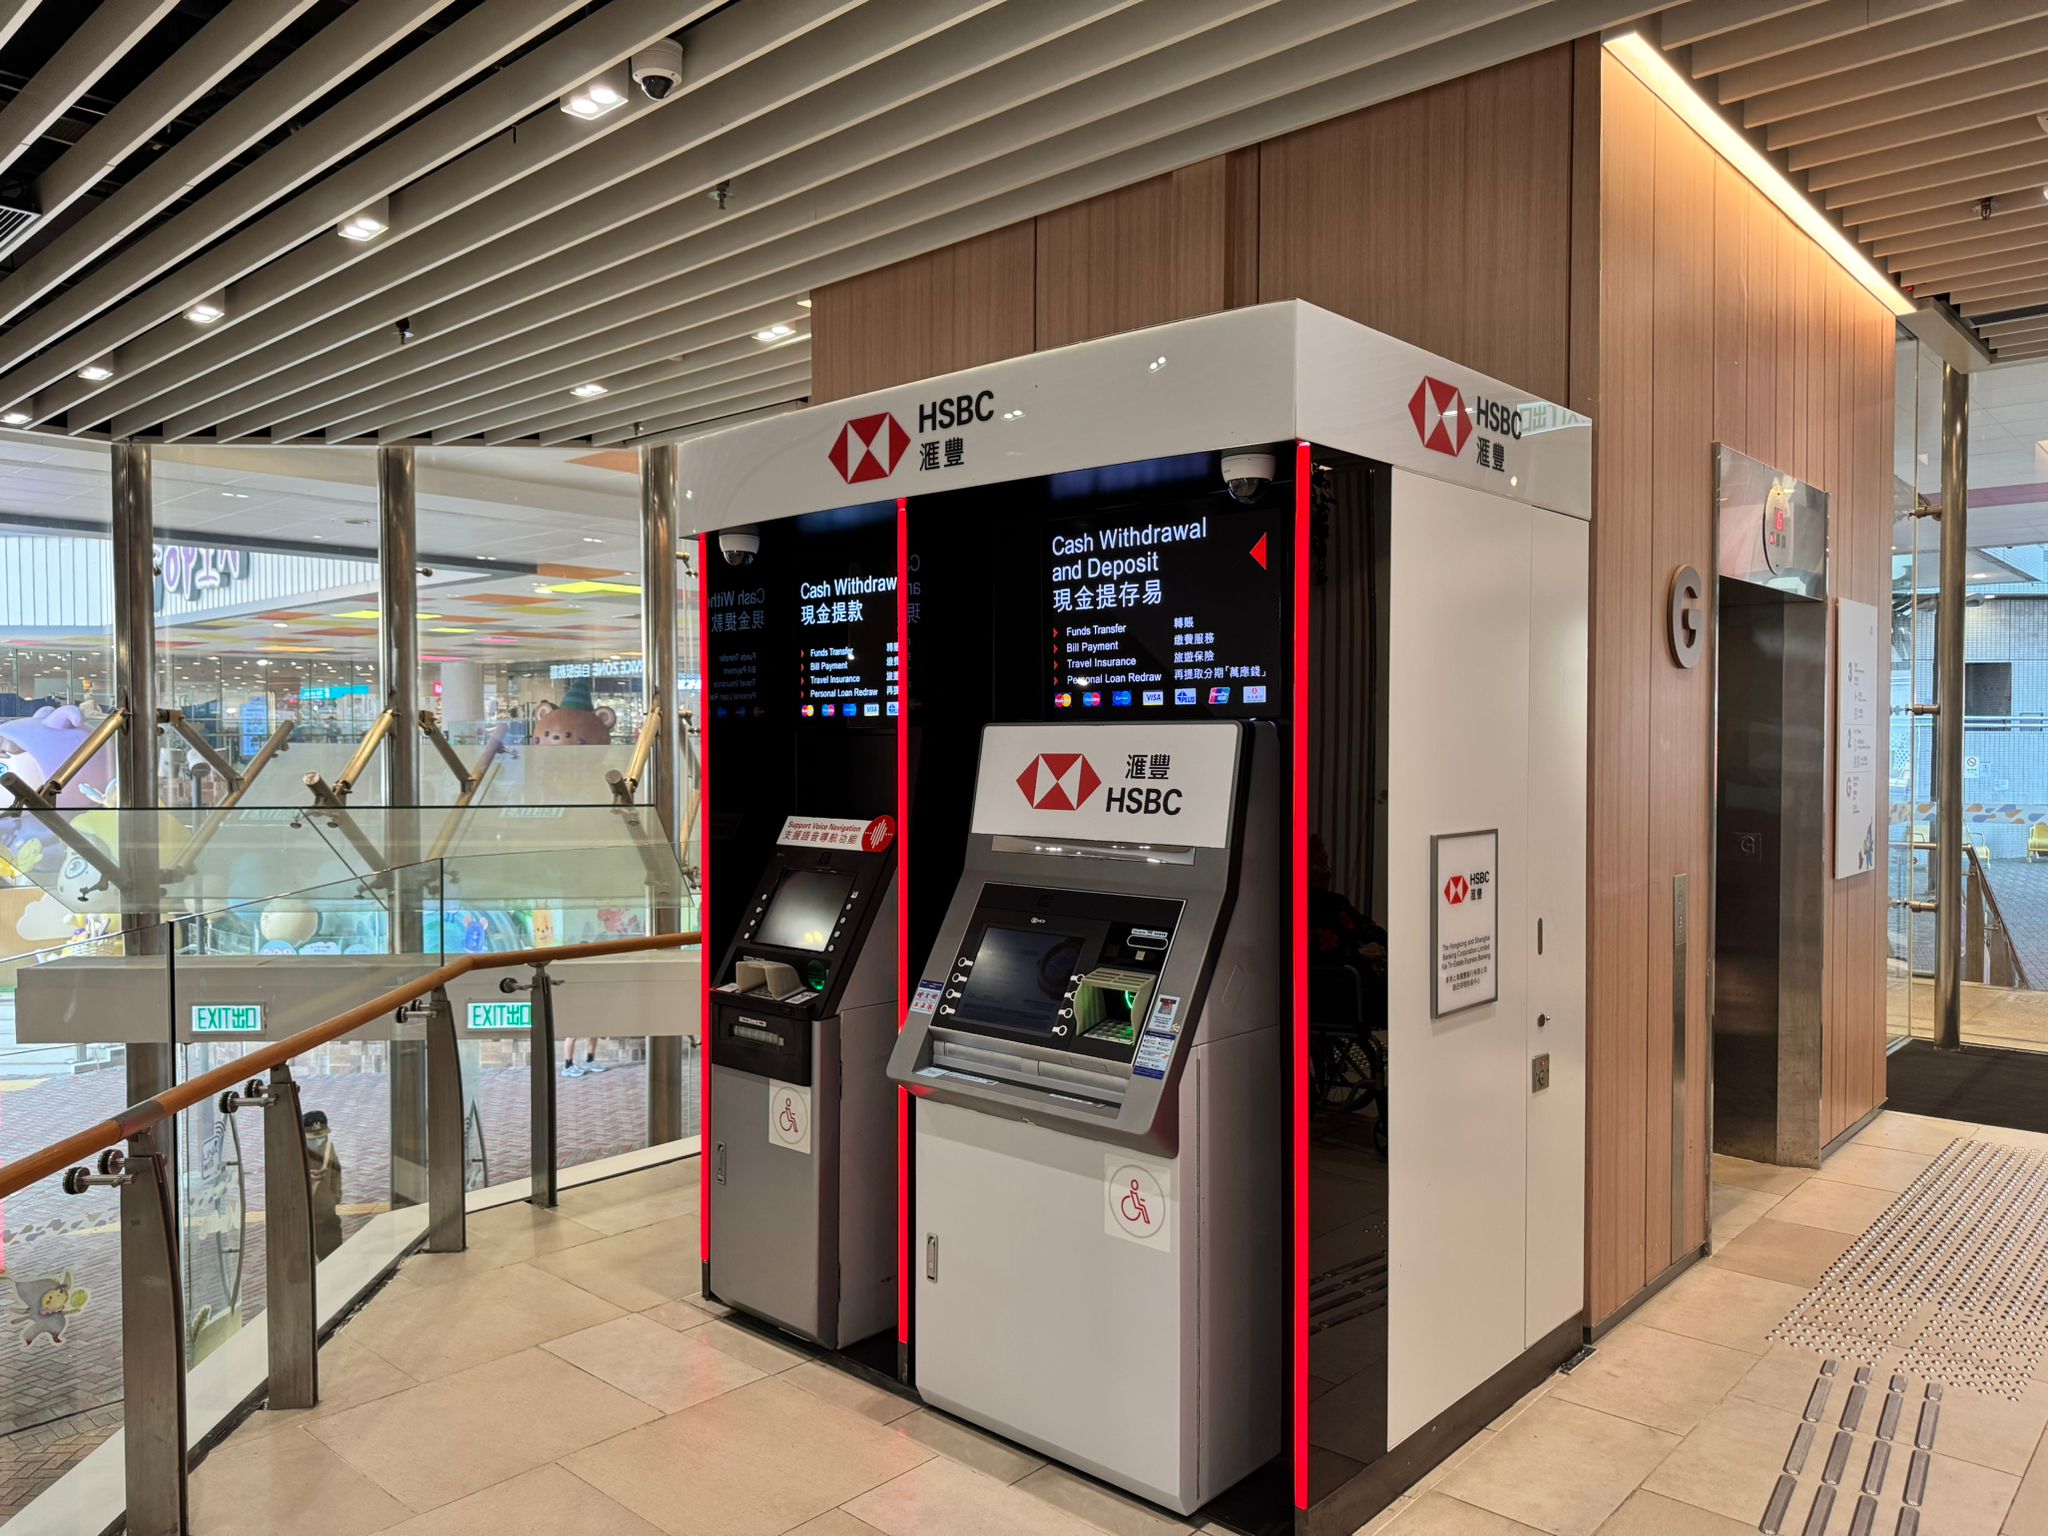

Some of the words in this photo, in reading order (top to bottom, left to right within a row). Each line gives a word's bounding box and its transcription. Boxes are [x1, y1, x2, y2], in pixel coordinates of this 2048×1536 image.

[918, 390, 994, 433] HSBC
[1476, 396, 1522, 440] HSBC
[919, 437, 964, 471] 滙豐
[1476, 436, 1505, 472] 滙豐
[1052, 533, 1094, 556] Cash
[1099, 516, 1207, 550] Withdrawal
[1052, 559, 1082, 582] and
[1088, 551, 1159, 580] Deposit
[800, 580, 831, 600] Cash
[834, 575, 898, 597] Withdraw
[1052, 579, 1162, 612] 現金提存易
[800, 599, 864, 626] 現金提款
[1066, 625, 1091, 637] Funds
[1093, 623, 1127, 635] Transfer
[810, 648, 828, 657] Funds
[1066, 642, 1080, 653] Bill
[1081, 640, 1119, 654] Payment
[810, 662, 820, 671] Bill
[821, 660, 848, 672] Payment
[1066, 658, 1093, 669] Travel
[1094, 656, 1137, 668] Insurance
[810, 675, 829, 684] Travel
[830, 674, 860, 684] Insurance
[1105, 673, 1126, 684] Loan
[1128, 672, 1162, 683] Redraw
[810, 689, 836, 698] Personal
[837, 688, 852, 697] Loan
[853, 687, 879, 697] Redraw
[1146, 693, 1161, 702] VISA
[1125, 753, 1170, 780] 滙豐
[1105, 787, 1183, 816] HSBC
[787, 820, 812, 830] Support
[812, 822, 828, 830] Voice
[828, 823, 862, 833] Navigation
[1470, 871, 1490, 885] HSBC
[198, 1007, 230, 1029] EXIT
[232, 1007, 256, 1029] 出口
[473, 1004, 506, 1026] EXIT
[506, 1004, 532, 1026] 出口
